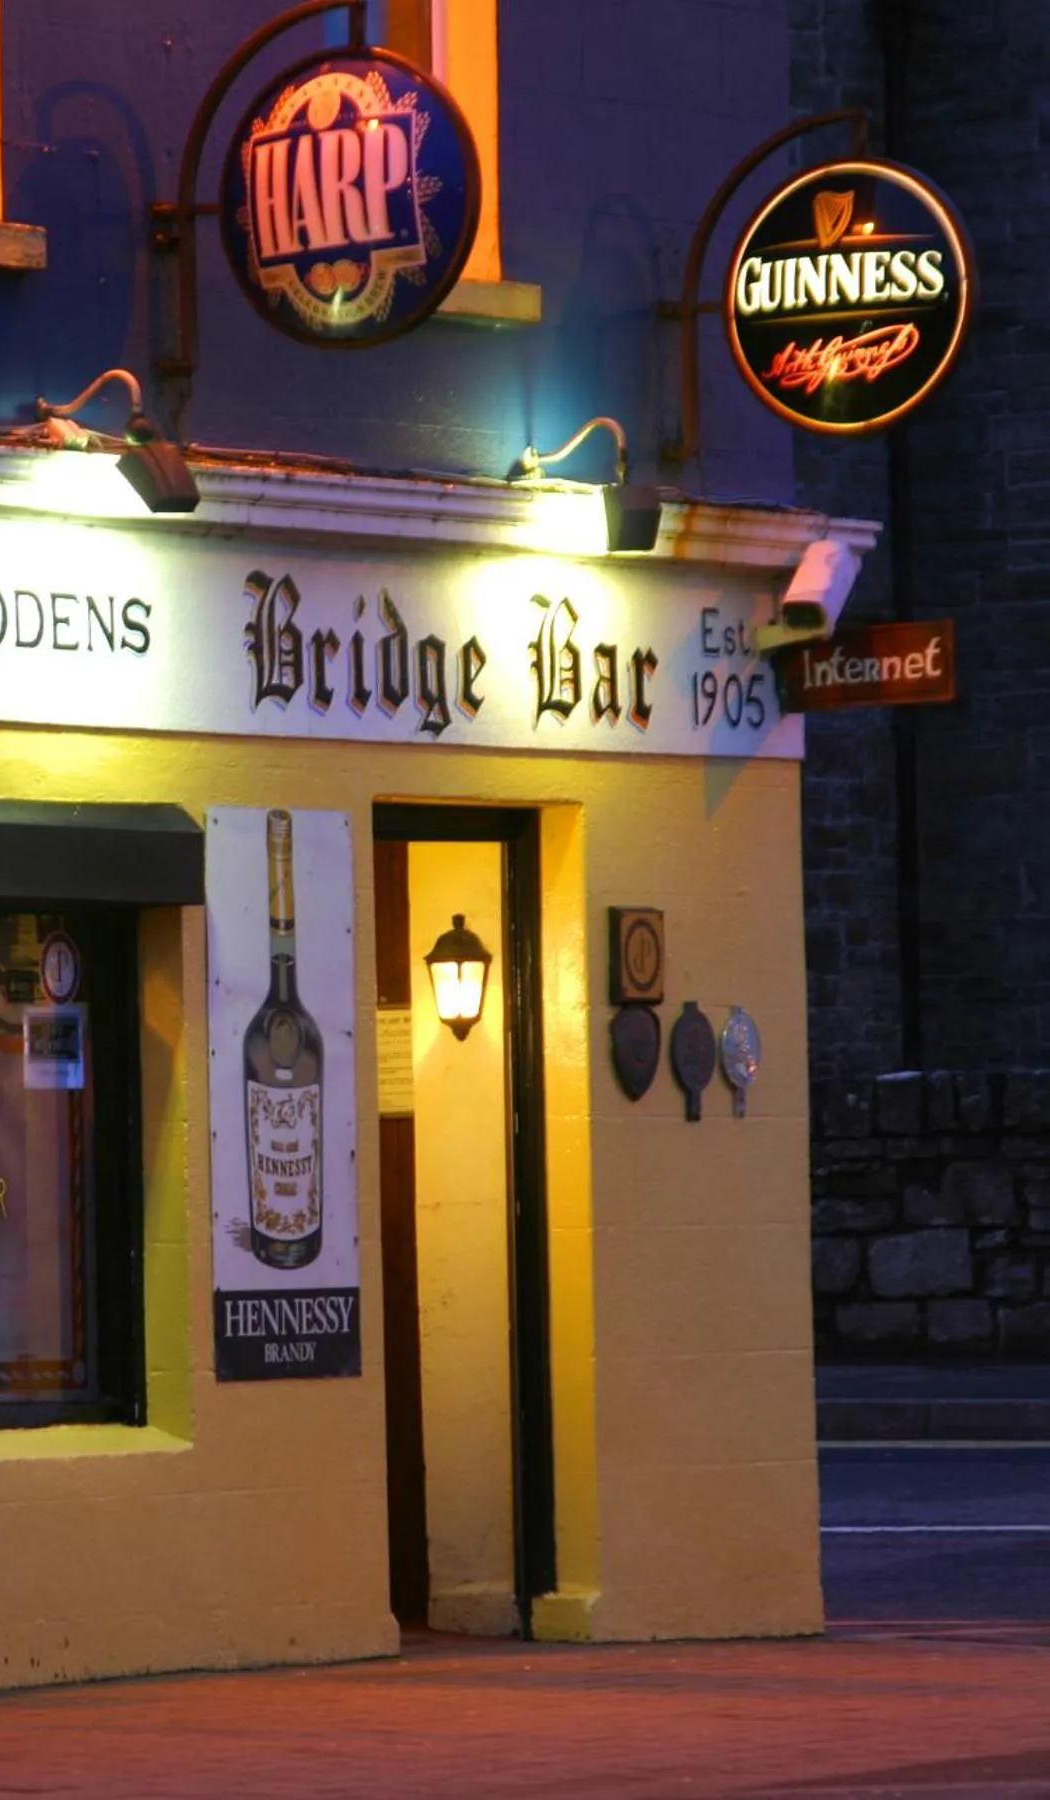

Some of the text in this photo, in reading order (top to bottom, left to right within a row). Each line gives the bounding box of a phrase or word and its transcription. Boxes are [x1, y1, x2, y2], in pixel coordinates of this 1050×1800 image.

[253, 119, 408, 259] HARP
[736, 249, 946, 315] GUINNESS
[243, 569, 487, 739] Bridge
[527, 593, 659, 734] Bar
[803, 635, 944, 690] Internet
[689, 671, 767, 730] 1905
[258, 1153, 313, 1177] HENNESSY
[224, 1297, 354, 1338] HENNESSY
[264, 1341, 317, 1363] BRANDY
